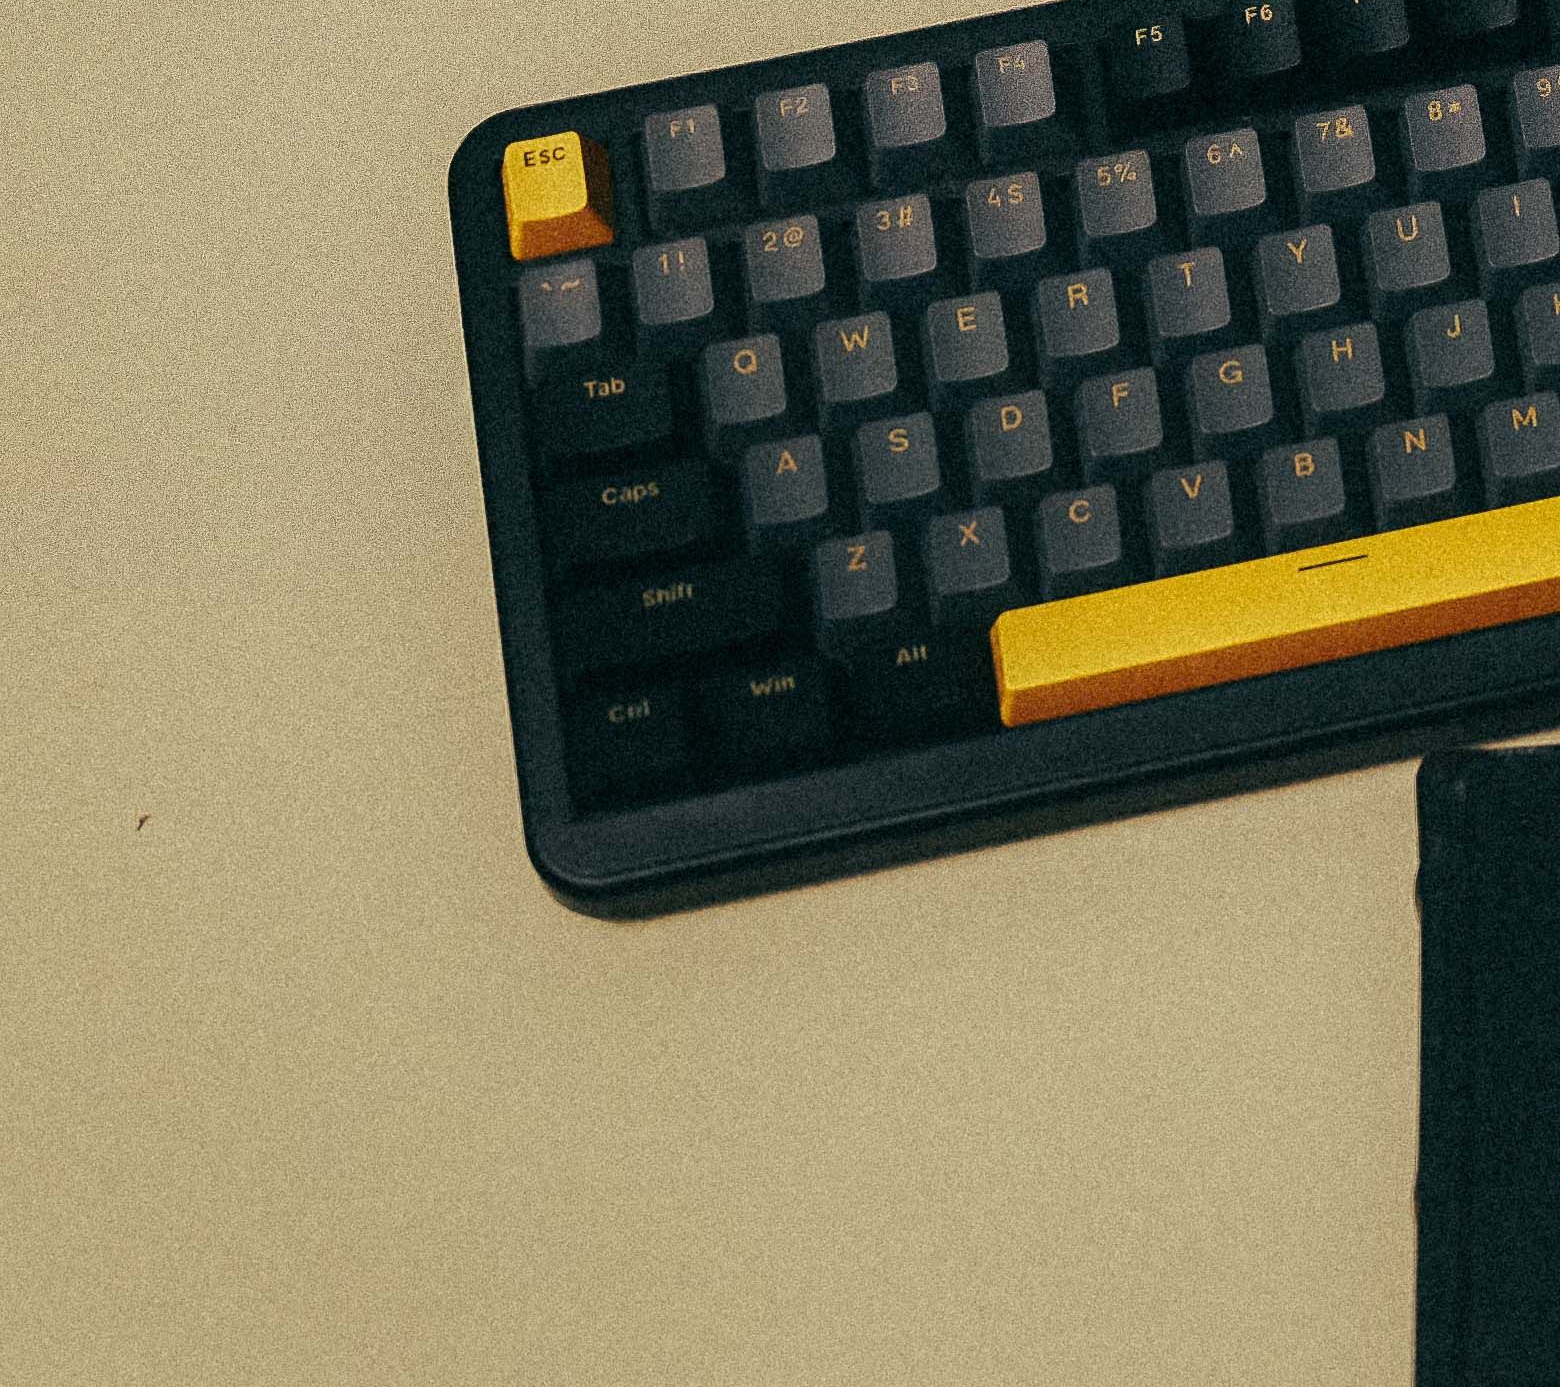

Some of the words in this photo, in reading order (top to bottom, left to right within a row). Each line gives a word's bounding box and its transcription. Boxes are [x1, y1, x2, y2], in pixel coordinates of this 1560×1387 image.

[1243, 1, 1275, 25] F6
[1134, 24, 1164, 46] F5
[1511, 195, 1522, 217] I
[1395, 215, 1420, 243] U
[1286, 238, 1308, 265] Y
[1178, 259, 1196, 283] T
[1064, 280, 1090, 310] R
[954, 304, 978, 333] E
[838, 324, 872, 354] W
[731, 346, 760, 376] Q
[584, 377, 626, 398] Tab
